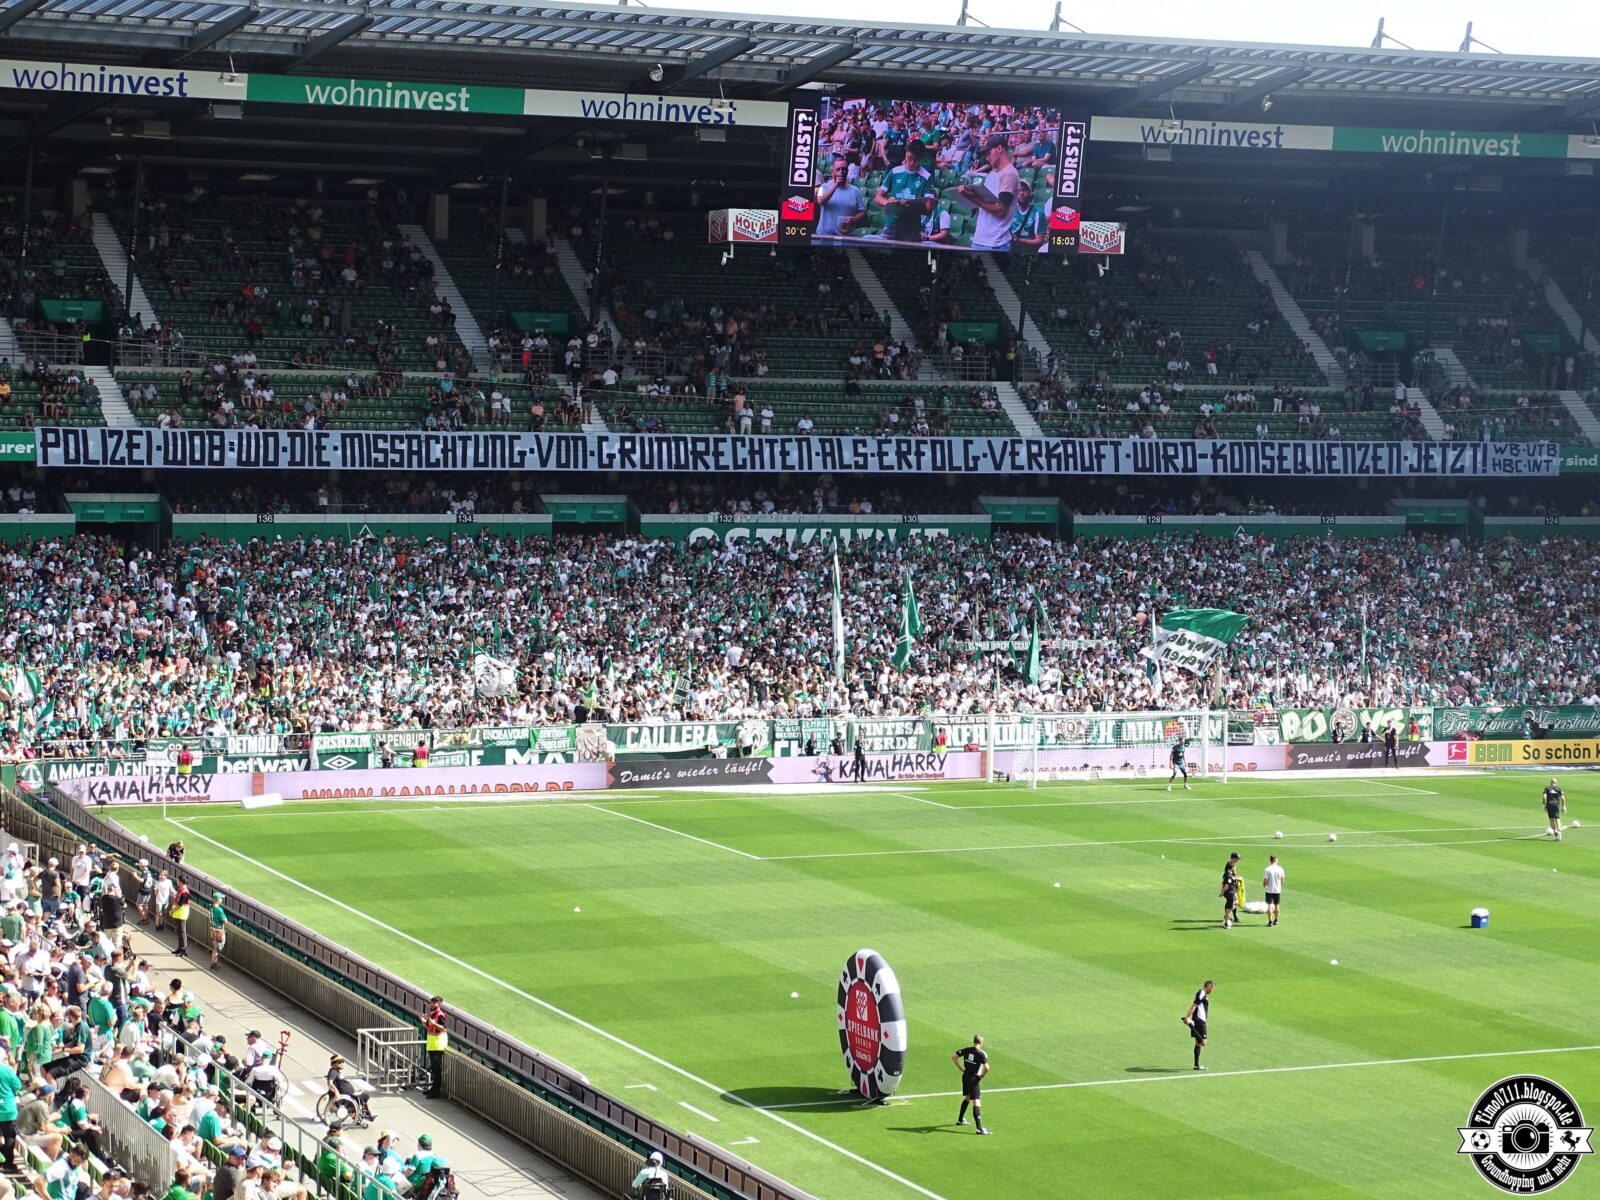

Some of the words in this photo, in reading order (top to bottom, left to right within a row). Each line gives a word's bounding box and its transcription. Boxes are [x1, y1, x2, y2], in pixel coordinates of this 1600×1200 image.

[12, 62, 188, 97] wohninvest
[304, 80, 470, 112] wohninvest
[580, 92, 736, 125] wohninvest
[1140, 119, 1284, 149] wohninvest
[794, 112, 813, 182] DURST?
[1381, 129, 1521, 158] wohninvest
[1061, 126, 1081, 193] DURST?
[1051, 236, 1075, 246] 15:03
[40, 427, 152, 466] POLIZEI
[163, 430, 225, 466] WOB
[237, 432, 279, 467] WO
[288, 432, 330, 467] DIE
[341, 433, 527, 468] MISSACHTUNG
[535, 434, 588, 469] VON
[598, 435, 812, 471] GRUNDRECHTEN
[818, 437, 868, 470] ALS
[877, 438, 980, 472] ERFOLG
[988, 439, 1122, 473] VERKAUFT
[1133, 440, 1197, 474] WIRD
[1211, 441, 1402, 475] KONSEQUENZEN
[1408, 442, 1488, 475] JETZT!
[1566, 454, 1598, 466] sind
[257, 514, 273, 523] 136
[456, 514, 472, 523] 134
[718, 514, 733, 523] 132
[903, 515, 918, 523] 130
[1146, 516, 1161, 524] 128
[1321, 516, 1335, 524] 126
[1545, 517, 1559, 525] 124
[626, 725, 718, 748] CAILLERA
[1298, 750, 1341, 765] Damit's
[1347, 750, 1383, 761] wieder
[1475, 744, 1513, 762] BBM
[1522, 744, 1540, 761] So
[1545, 743, 1591, 760] schön
[217, 755, 308, 773] betway
[620, 767, 671, 783] Damit's
[677, 767, 718, 778] wieder
[725, 759, 763, 776] läuft!
[847, 1019, 879, 1043] SPIELBANK
